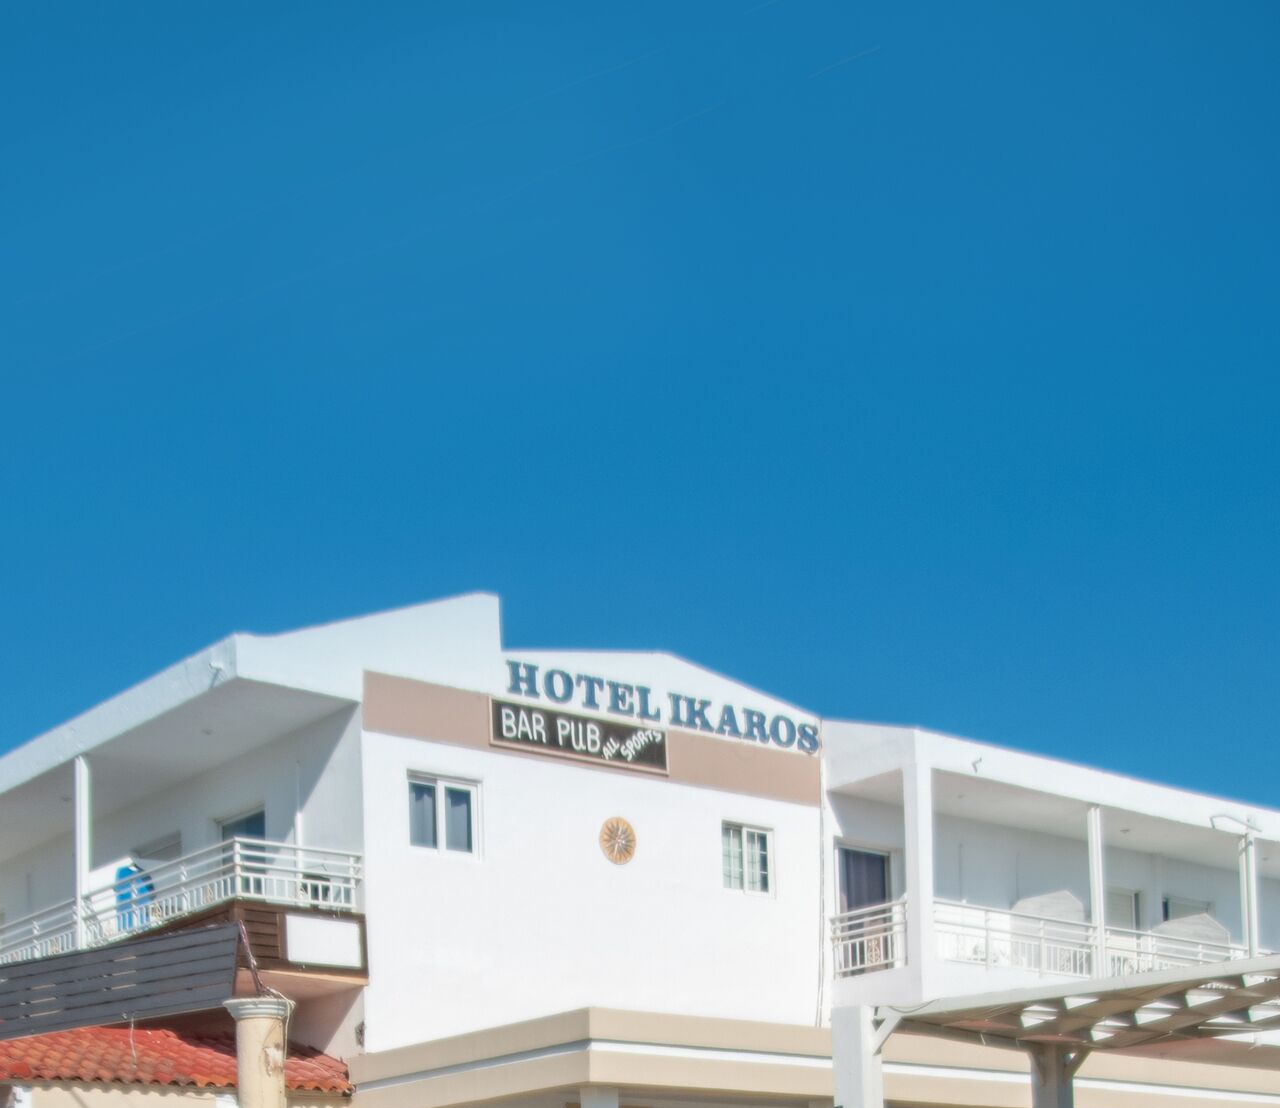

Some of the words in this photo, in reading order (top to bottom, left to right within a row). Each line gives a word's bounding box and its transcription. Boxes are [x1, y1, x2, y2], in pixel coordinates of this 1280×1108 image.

[501, 706, 547, 744] BAR
[556, 717, 601, 753] PUB
[506, 659, 661, 722] HOTEL
[667, 692, 819, 755] IKAROS
[601, 738, 620, 760] ALL
[620, 729, 662, 762] SPORTS
